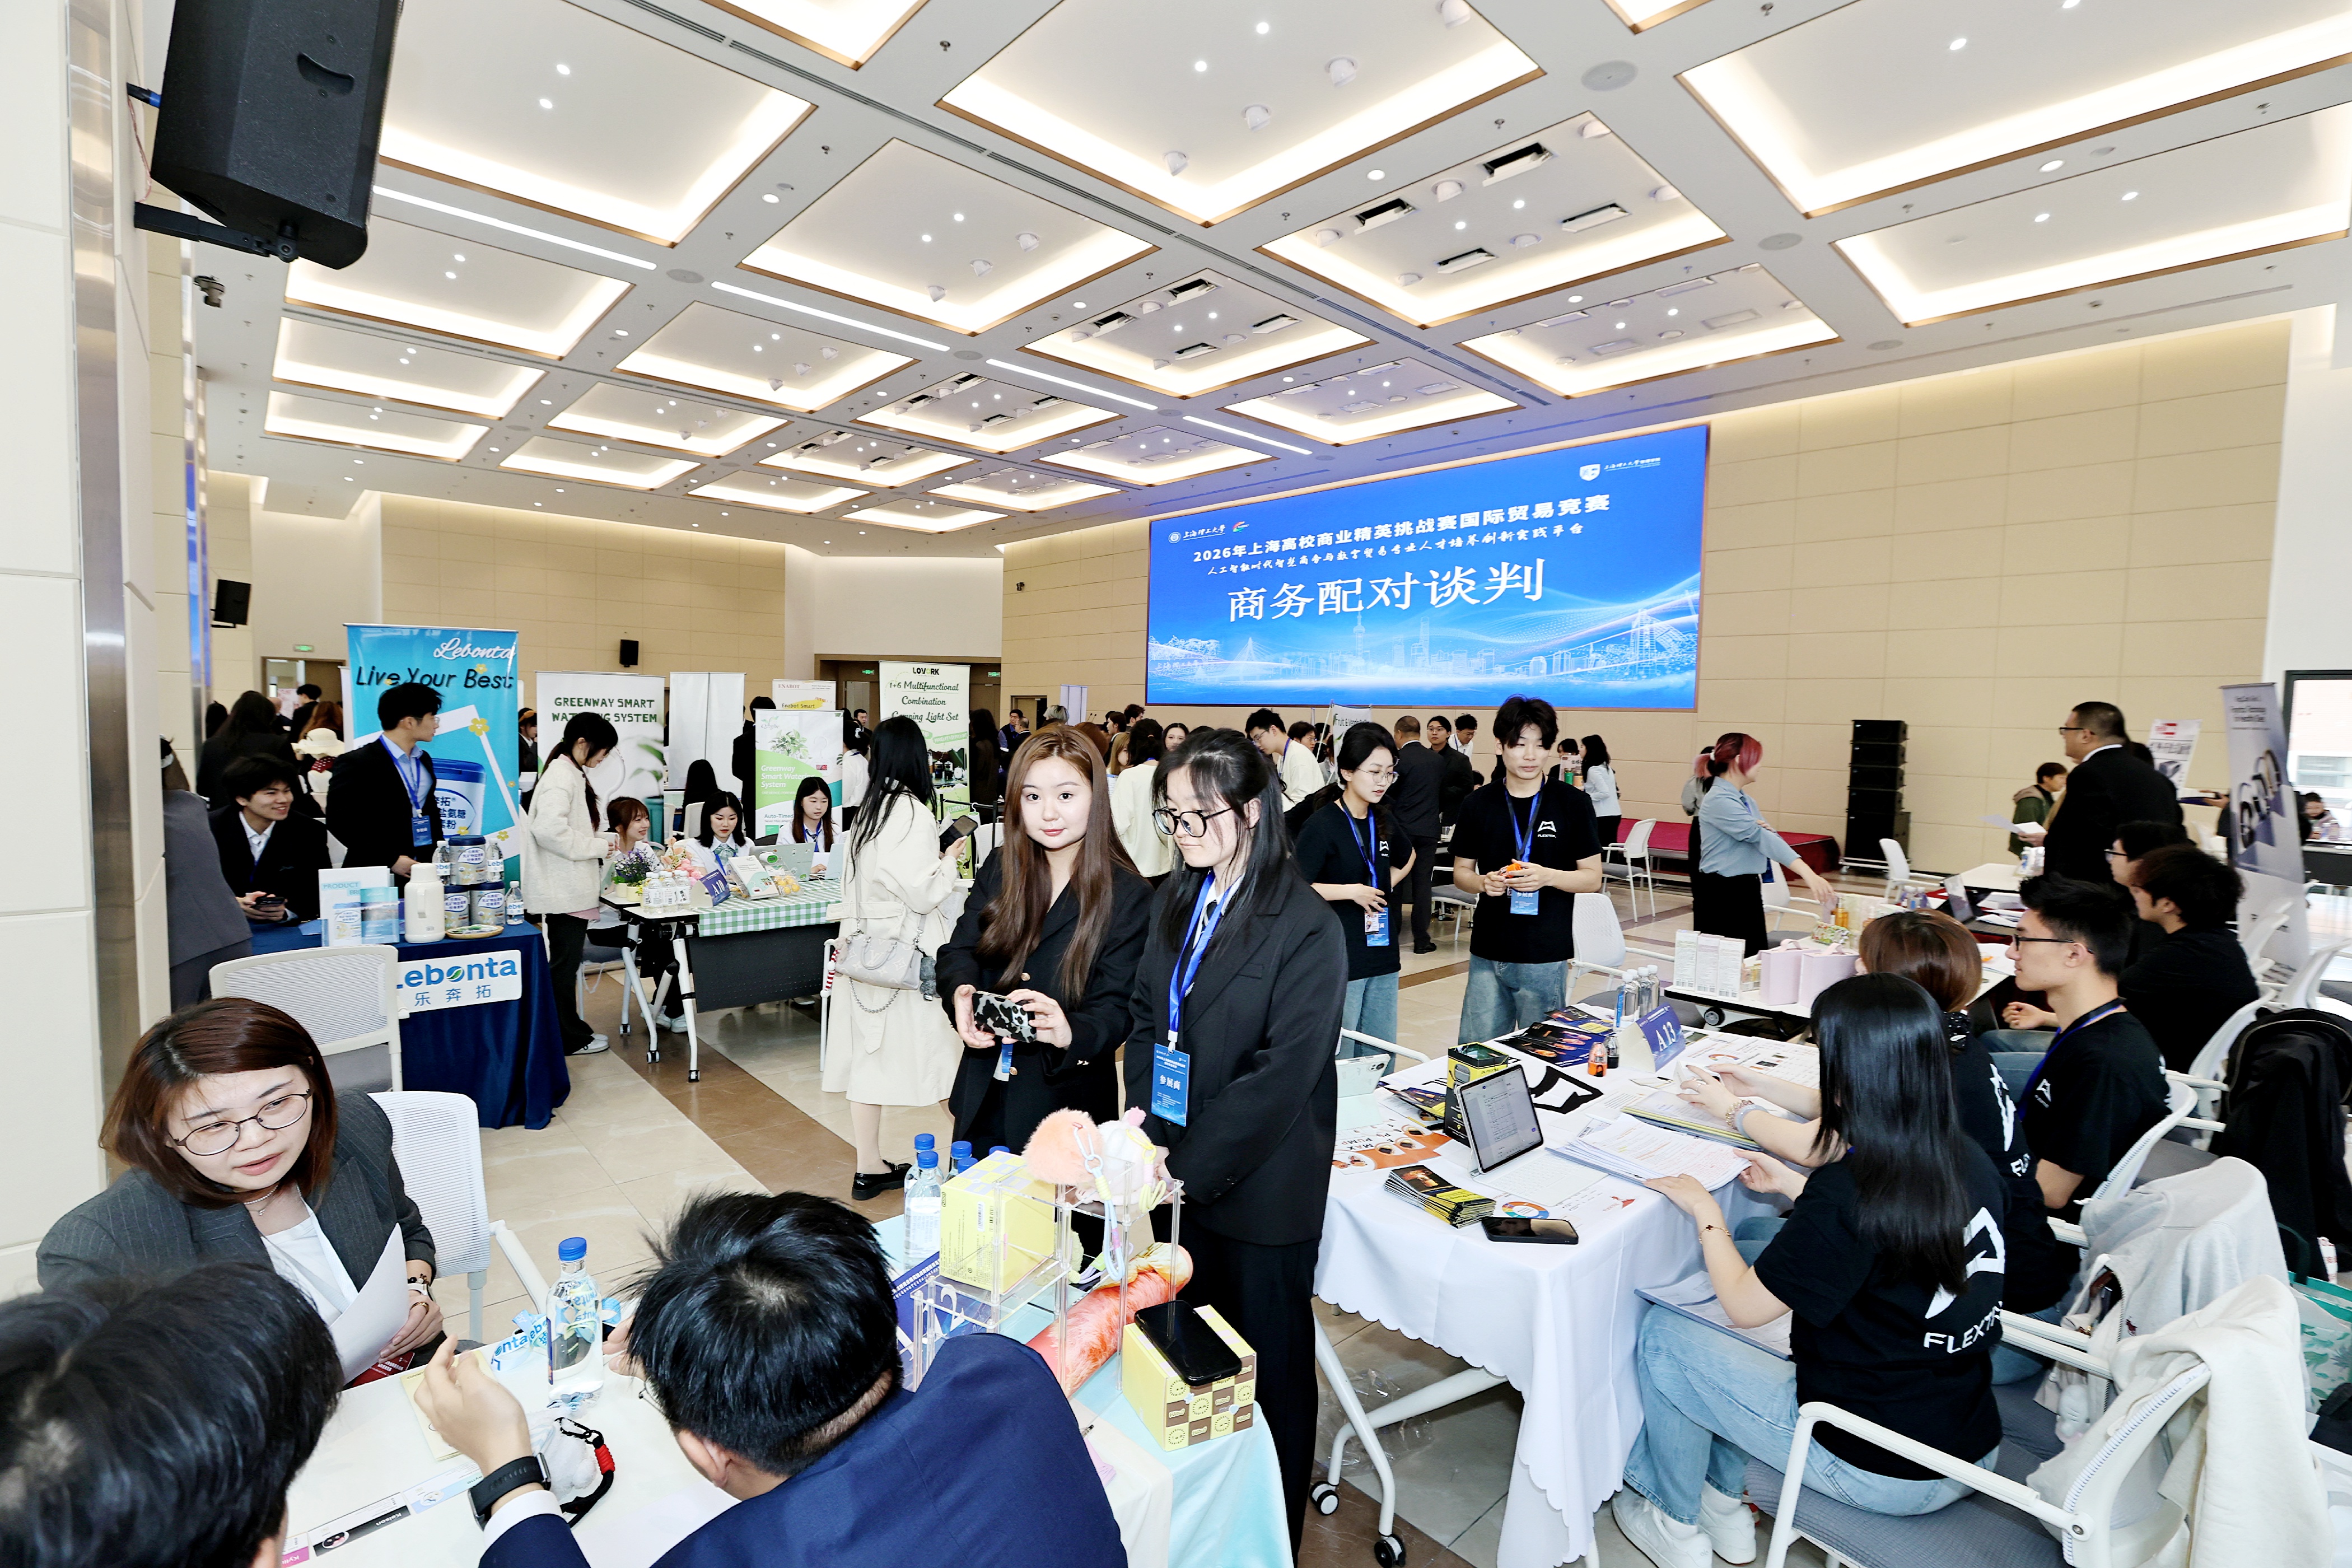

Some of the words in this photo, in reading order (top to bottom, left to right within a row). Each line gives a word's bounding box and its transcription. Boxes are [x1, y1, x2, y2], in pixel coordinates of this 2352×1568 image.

[1193, 494, 1610, 563] 2026年上海高校商业精英挑战赛国际贸易竞赛
[1227, 558, 1546, 622] 商务配对谈判
[433, 637, 516, 660] Lebonta
[356, 666, 400, 686] Live
[404, 668, 457, 687] Your
[464, 669, 514, 689] Best
[904, 681, 959, 691] Multifunctional
[554, 697, 614, 708] GREENWAY
[617, 698, 655, 708] SMART
[902, 696, 946, 706] Combination
[614, 713, 657, 722] SYSTEM
[926, 712, 945, 723] Light
[946, 712, 959, 721] Set
[396, 958, 517, 990] ebonta
[414, 984, 491, 1007] 乐奔拓
[1159, 1074, 1181, 1091] 参展商
[376, 1513, 402, 1527] Kelson
